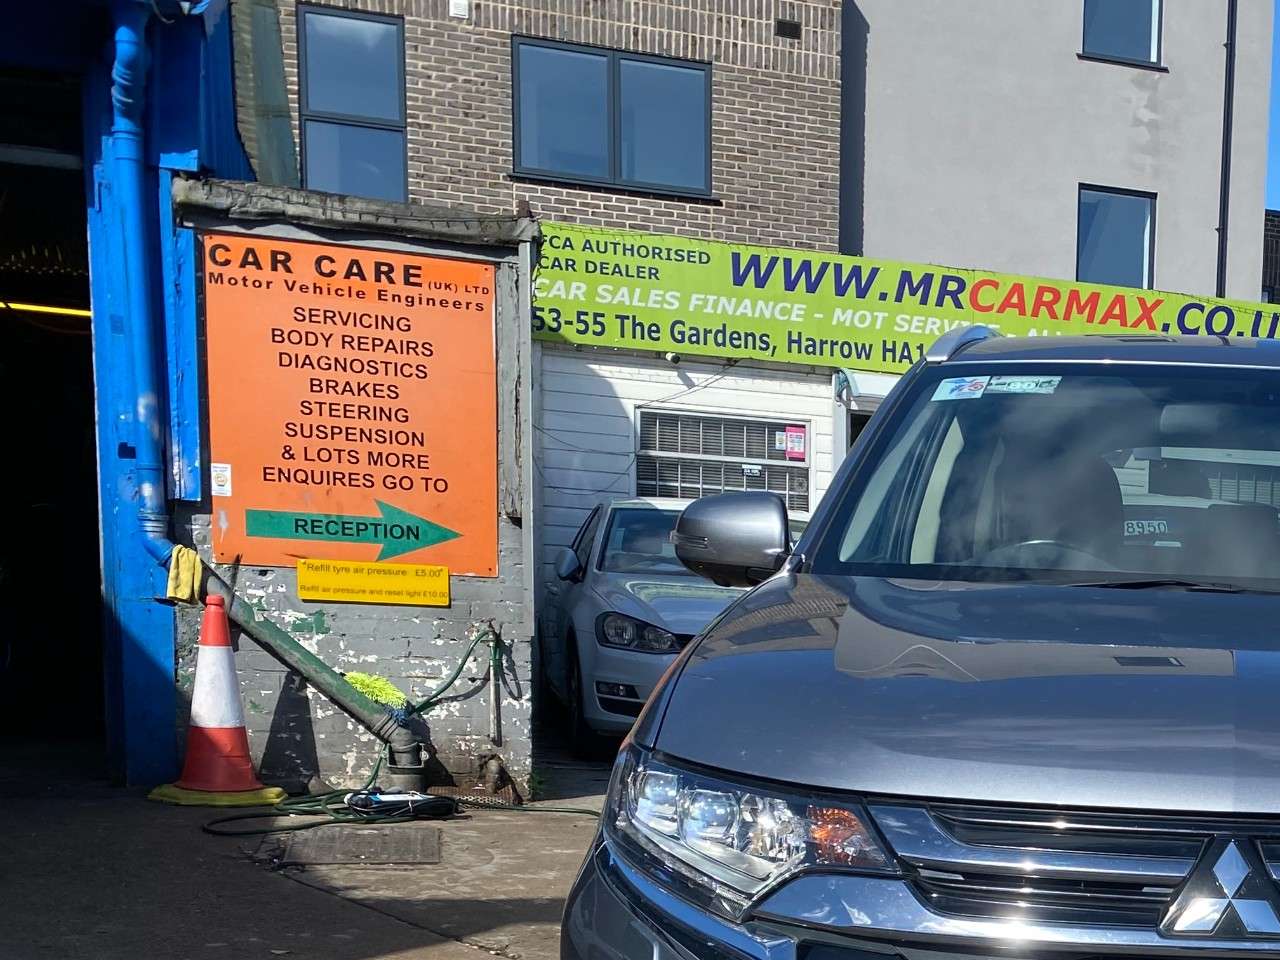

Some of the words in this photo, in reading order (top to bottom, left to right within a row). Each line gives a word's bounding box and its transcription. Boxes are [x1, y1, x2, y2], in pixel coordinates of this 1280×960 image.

[582, 239, 711, 265] AUTHORISED
[209, 244, 293, 274] CAR
[314, 255, 422, 287] CARE
[428, 281, 458, 293] (UK)
[465, 285, 489, 295] LTD
[539, 256, 577, 272] CAR
[585, 260, 660, 280] DEALER
[209, 272, 273, 289] Motor
[284, 279, 366, 299] Vehicle
[378, 289, 484, 311] Engineers
[293, 307, 411, 332] SERVICING
[535, 278, 587, 301] CAR
[595, 284, 680, 310] SALES
[688, 294, 807, 322] FINANCE
[832, 308, 888, 330] MOT
[893, 314, 1000, 336] SERV
[271, 328, 334, 348] BODY
[341, 334, 434, 357] REPAIRS
[531, 306, 606, 337] 53-55
[615, 314, 661, 341] The
[669, 320, 777, 357] Gardens,
[787, 330, 873, 361] Harrow
[279, 352, 428, 379] DIAGNOSTICS
[309, 378, 400, 399] BRAKES
[300, 400, 409, 423] STEERING
[285, 422, 425, 447] SUSPENSION
[281, 445, 295, 460] &
[304, 447, 360, 465] LOTS
[368, 451, 430, 469] MORE
[263, 467, 375, 488] ENQUIRES
[383, 475, 413, 491] GO
[421, 477, 448, 493] TO
[294, 518, 420, 540] RECEPTION
[333, 564, 350, 574] tyre
[367, 567, 408, 577] pressure
[300, 584, 319, 592] Refill
[333, 587, 367, 596] pressure
[369, 588, 384, 596] and
[405, 590, 421, 598] light
